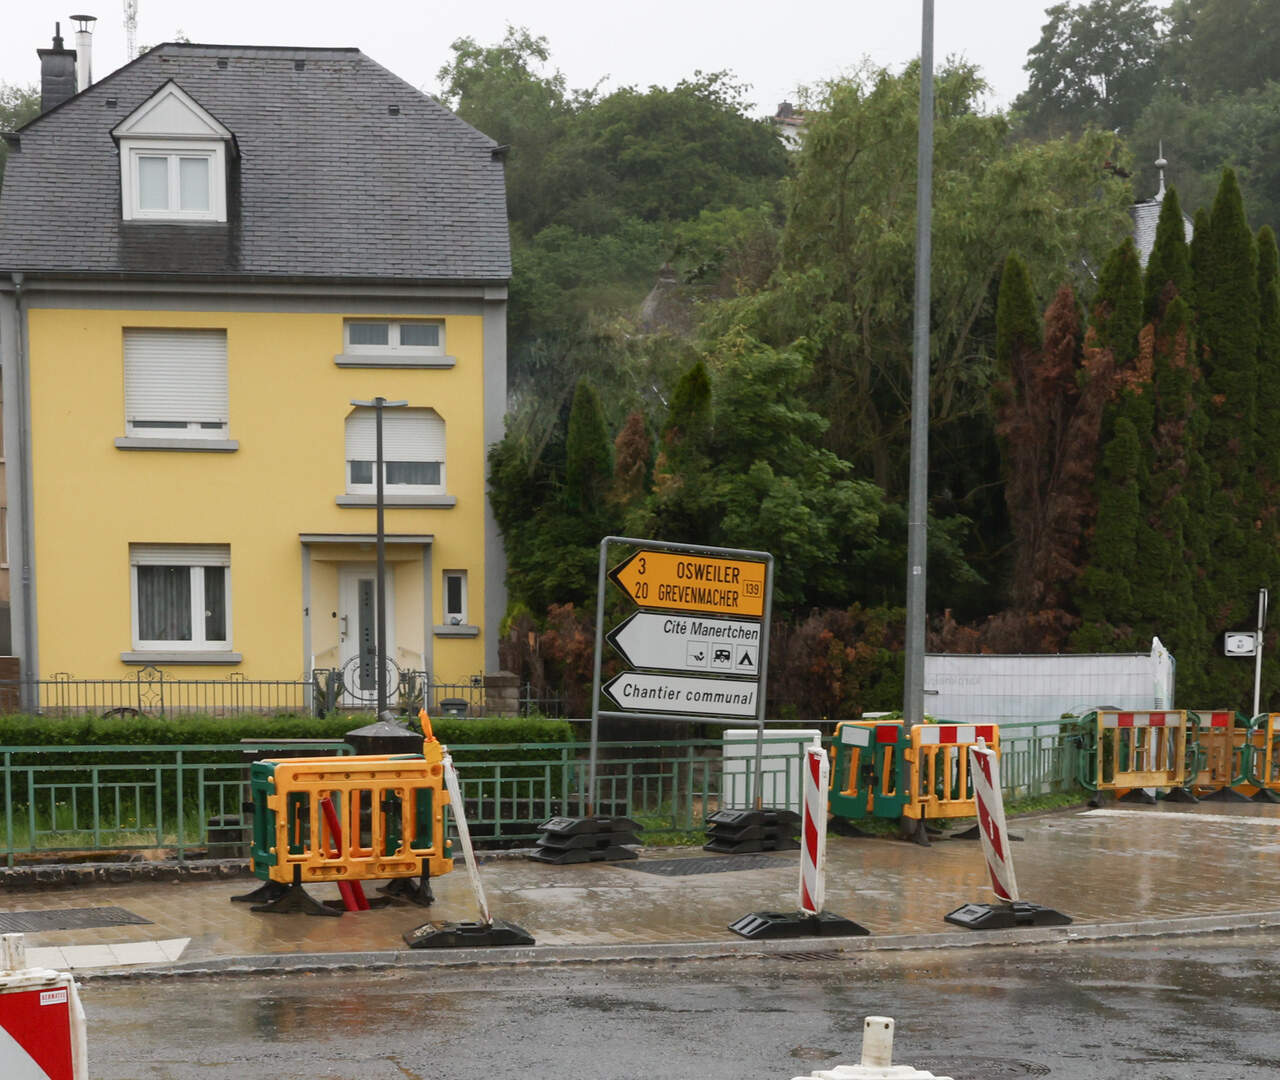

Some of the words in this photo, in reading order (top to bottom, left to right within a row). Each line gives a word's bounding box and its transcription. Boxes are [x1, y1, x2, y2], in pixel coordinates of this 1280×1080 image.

[637, 557, 646, 575] 3
[677, 561, 740, 584] OSWEILER
[634, 581, 649, 599] 20
[658, 583, 739, 607] GREVENMACHER
[745, 583, 760, 595] 139
[663, 619, 687, 635] Cité
[690, 621, 759, 640] Manertchen
[623, 683, 680, 700] Chantier
[686, 689, 753, 704] communal
